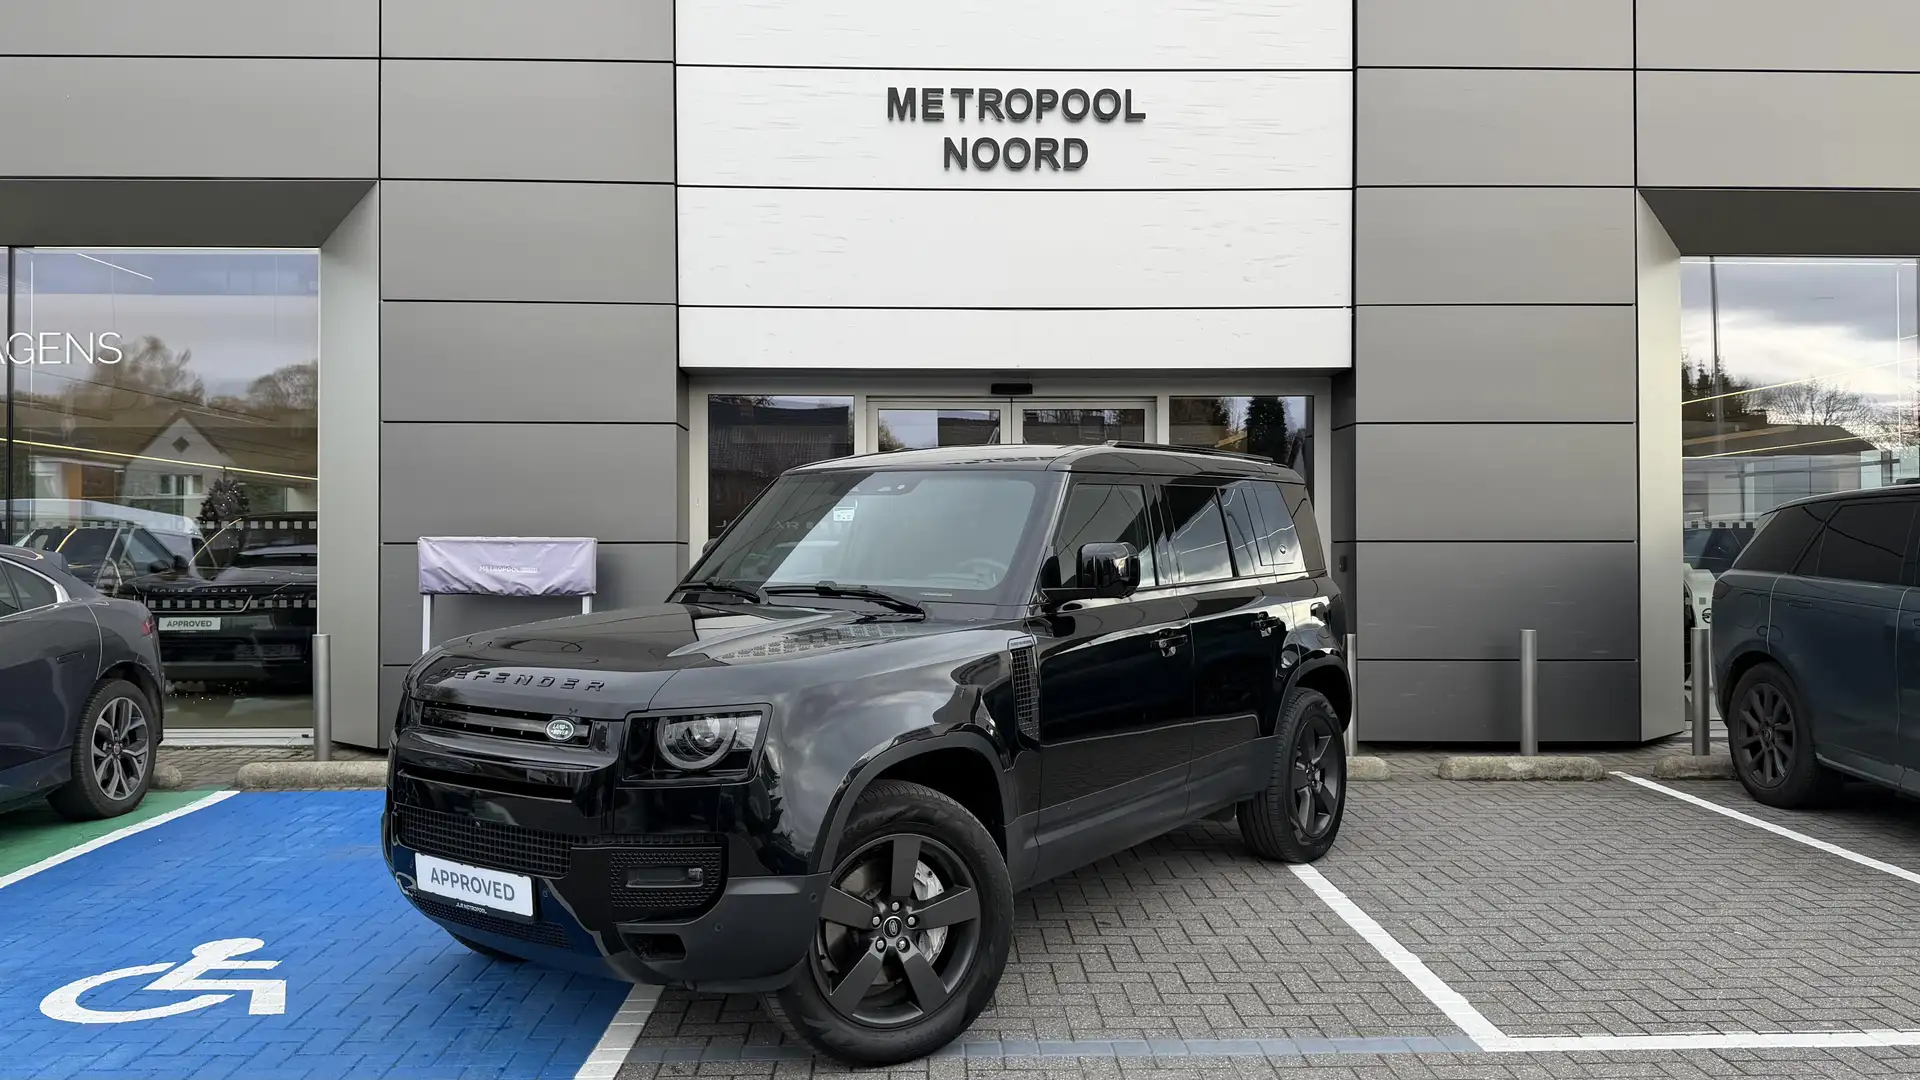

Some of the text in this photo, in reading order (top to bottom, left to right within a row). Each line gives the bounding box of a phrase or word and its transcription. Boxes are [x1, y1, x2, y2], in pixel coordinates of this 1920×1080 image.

[887, 86, 1147, 122] METROPOOL
[943, 137, 1089, 170] NOORD
[0, 331, 123, 365] GENS
[166, 620, 213, 628] APPROVED
[439, 668, 605, 692] DEFENDER
[430, 867, 515, 901] APPROVED
